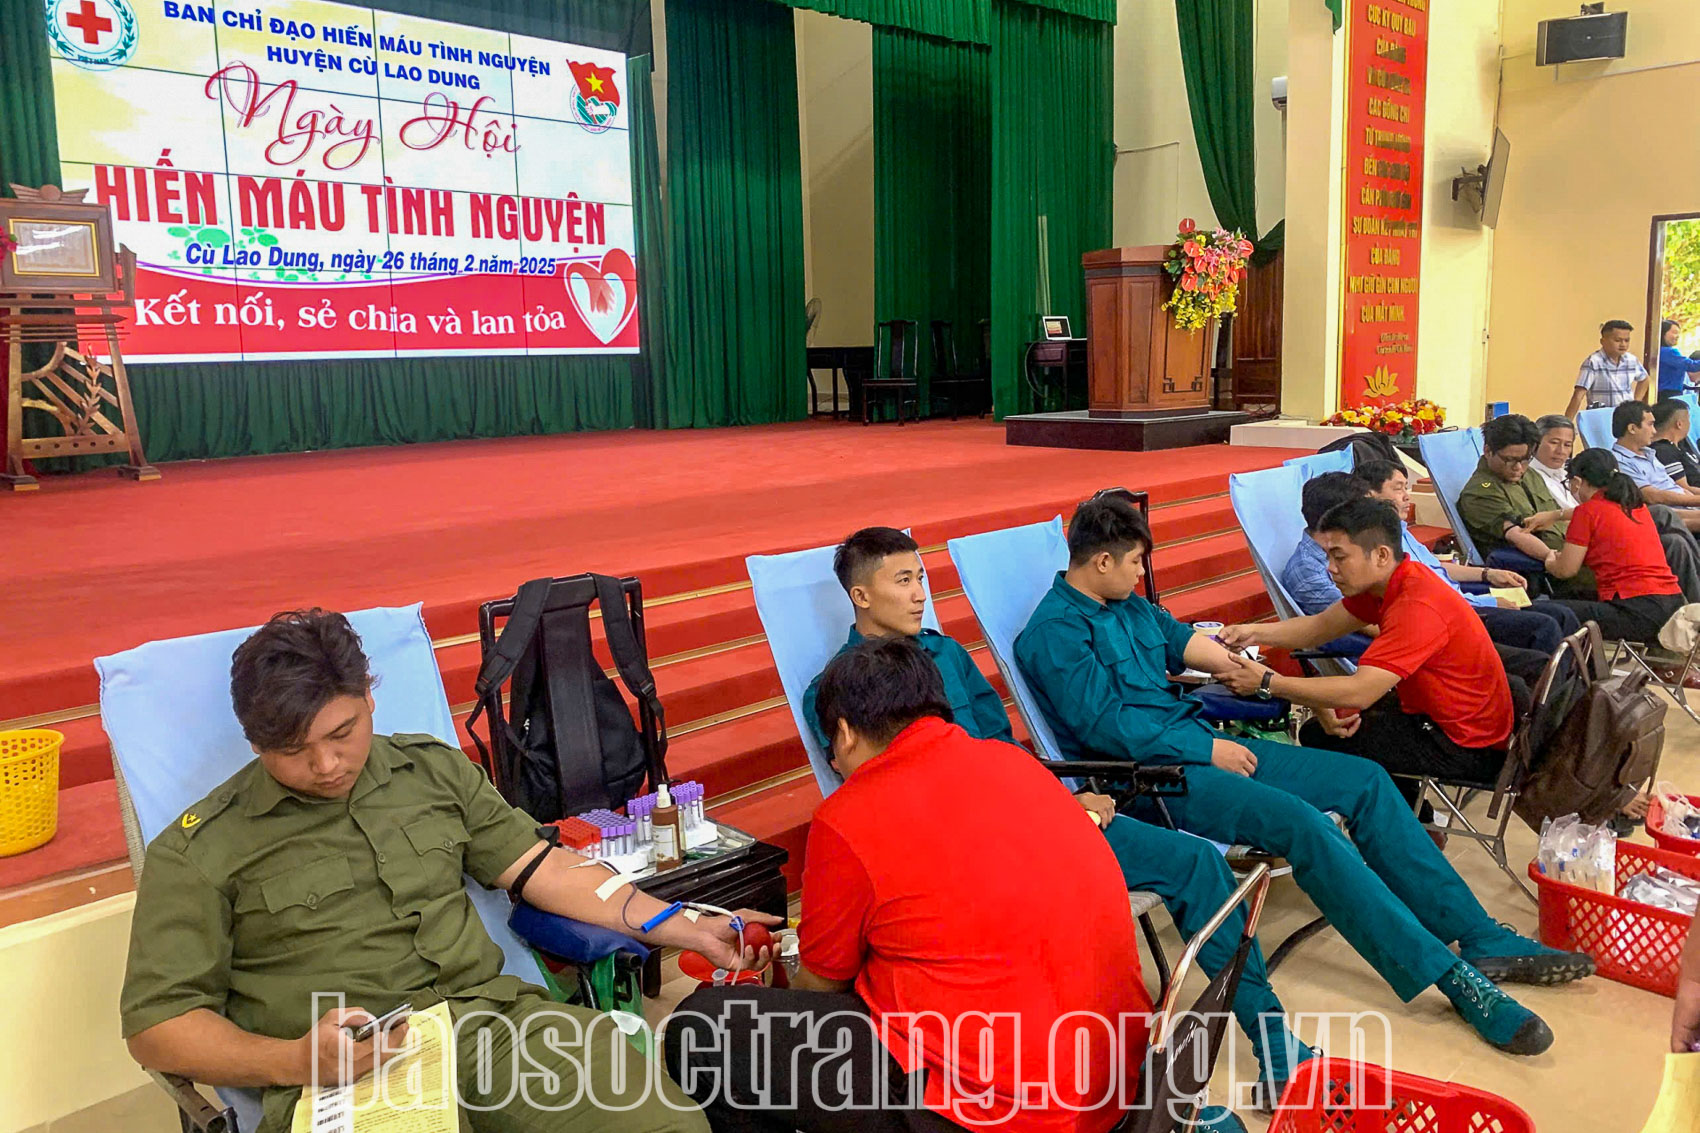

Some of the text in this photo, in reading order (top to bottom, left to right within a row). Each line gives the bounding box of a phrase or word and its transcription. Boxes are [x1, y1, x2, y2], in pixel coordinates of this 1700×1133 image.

[164, 1, 550, 77] BAN CHỈ ĐẠO HIẾN MÁU TÌNH NGUYỆN
[267, 45, 480, 90] HUYỆN CÙ LAO DUNG
[205, 60, 381, 170] Ngày
[399, 91, 521, 158] Hội
[94, 148, 606, 253] HIẾN MÁU TÌNH NGUYỆN
[186, 243, 557, 276] Cù Lao Dung, ngày 26 tháng 2 năm 2025
[134, 288, 567, 336] Kết nối, sẻ chia và lan tỏa
